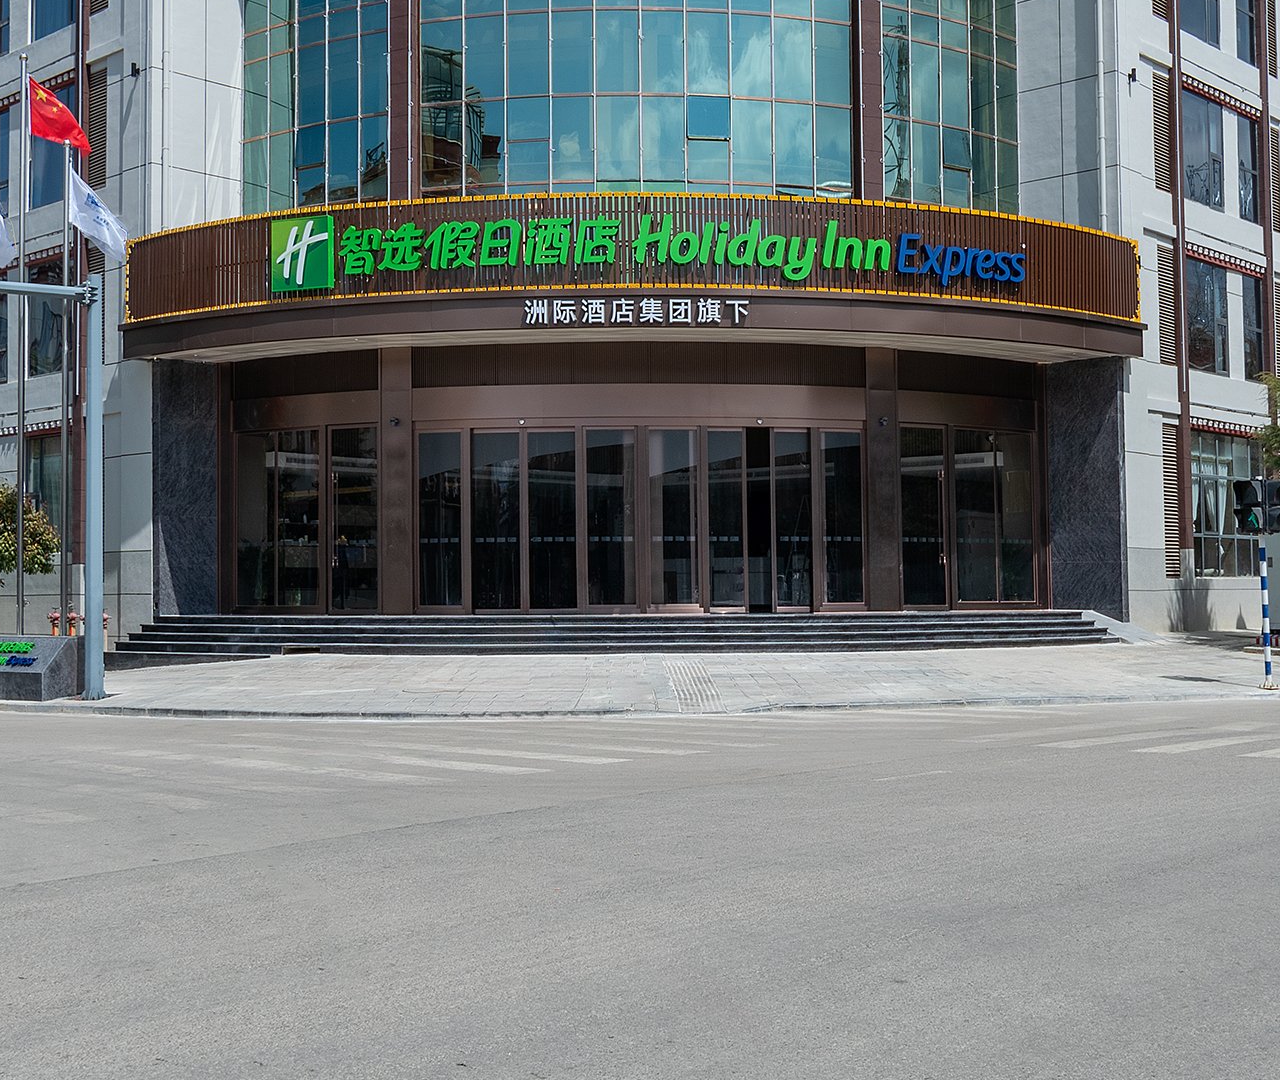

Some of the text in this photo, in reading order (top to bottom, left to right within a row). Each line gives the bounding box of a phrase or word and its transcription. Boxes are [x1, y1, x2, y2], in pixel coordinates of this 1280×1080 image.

[338, 215, 621, 276] 智选假日酒店
[632, 213, 1027, 286] Holiday Inn Express
[524, 297, 751, 325] 洲际酒店集团旗下
